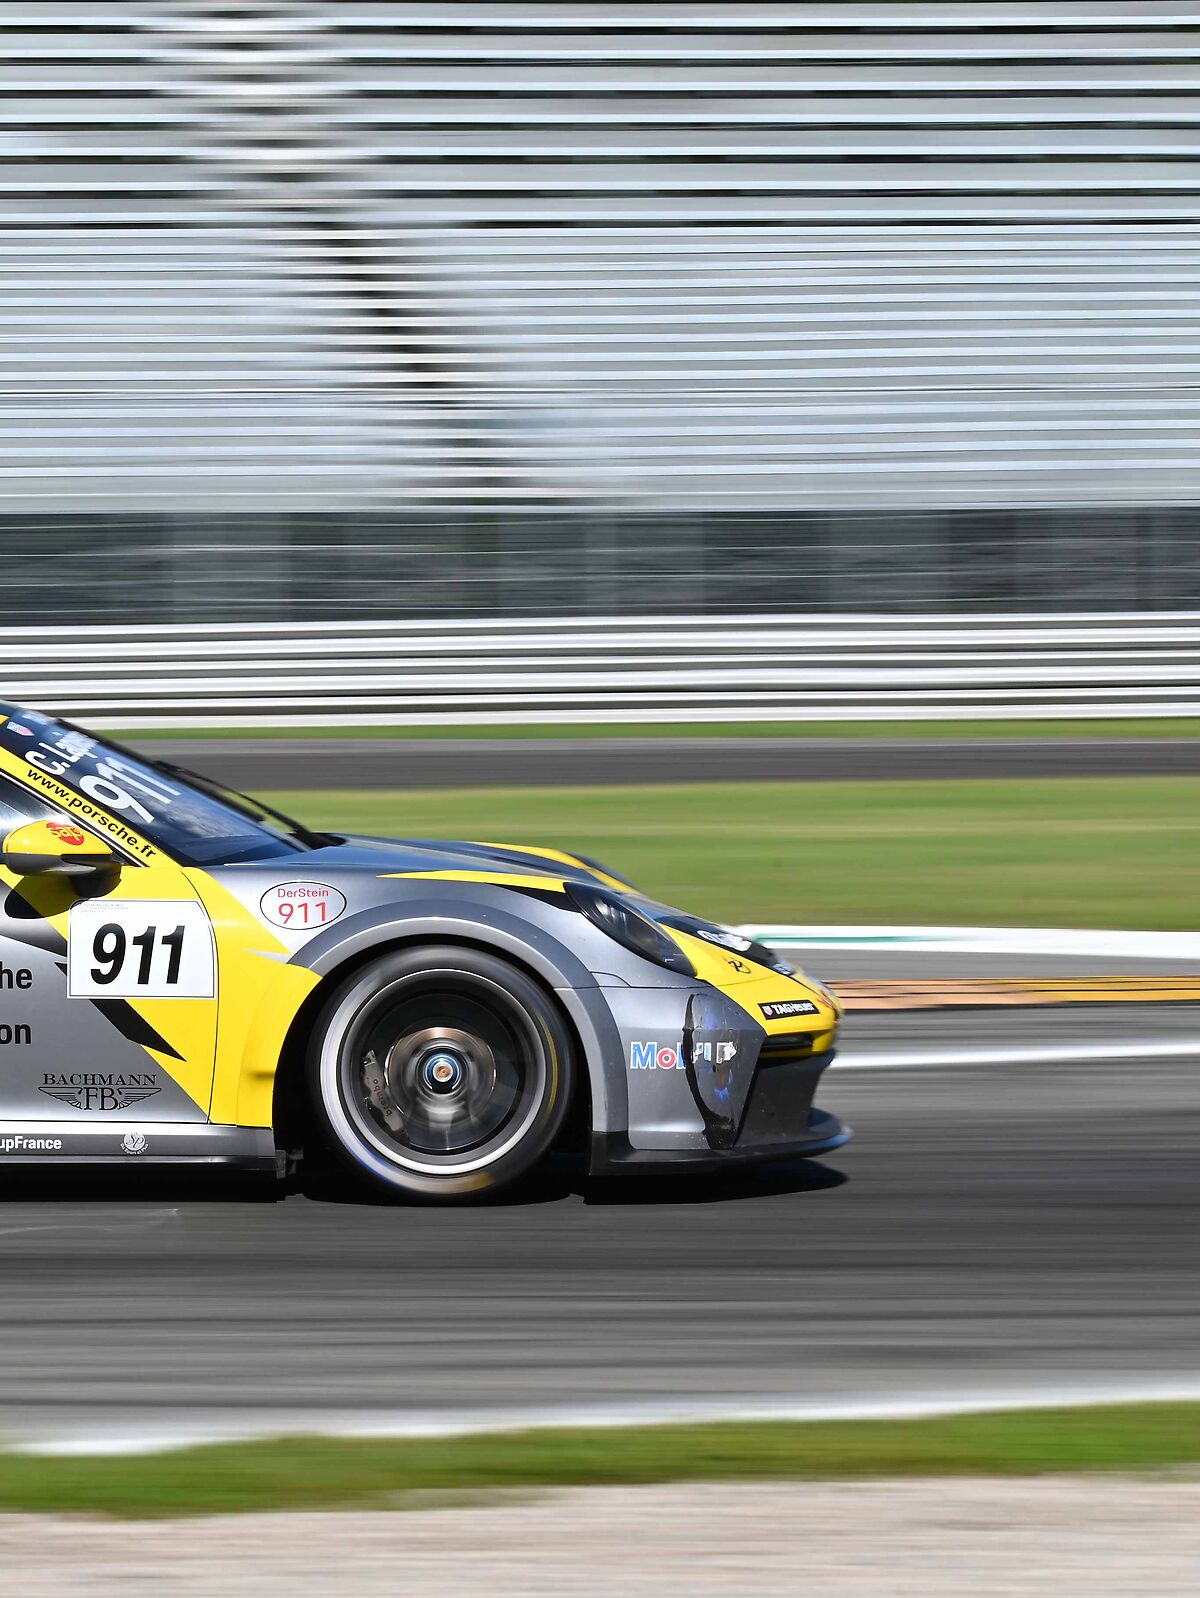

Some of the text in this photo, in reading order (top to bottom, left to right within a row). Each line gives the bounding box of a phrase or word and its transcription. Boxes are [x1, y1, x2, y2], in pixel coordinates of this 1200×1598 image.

[79, 756, 182, 824] 911
[27, 768, 157, 859] www.porsche.fr
[277, 888, 329, 898] DerStein
[278, 901, 327, 924] 911
[90, 923, 186, 985] 911
[43, 1073, 157, 1086] BACHMANN
[82, 1086, 119, 1110] FB
[373, 1079, 393, 1117] brembo
